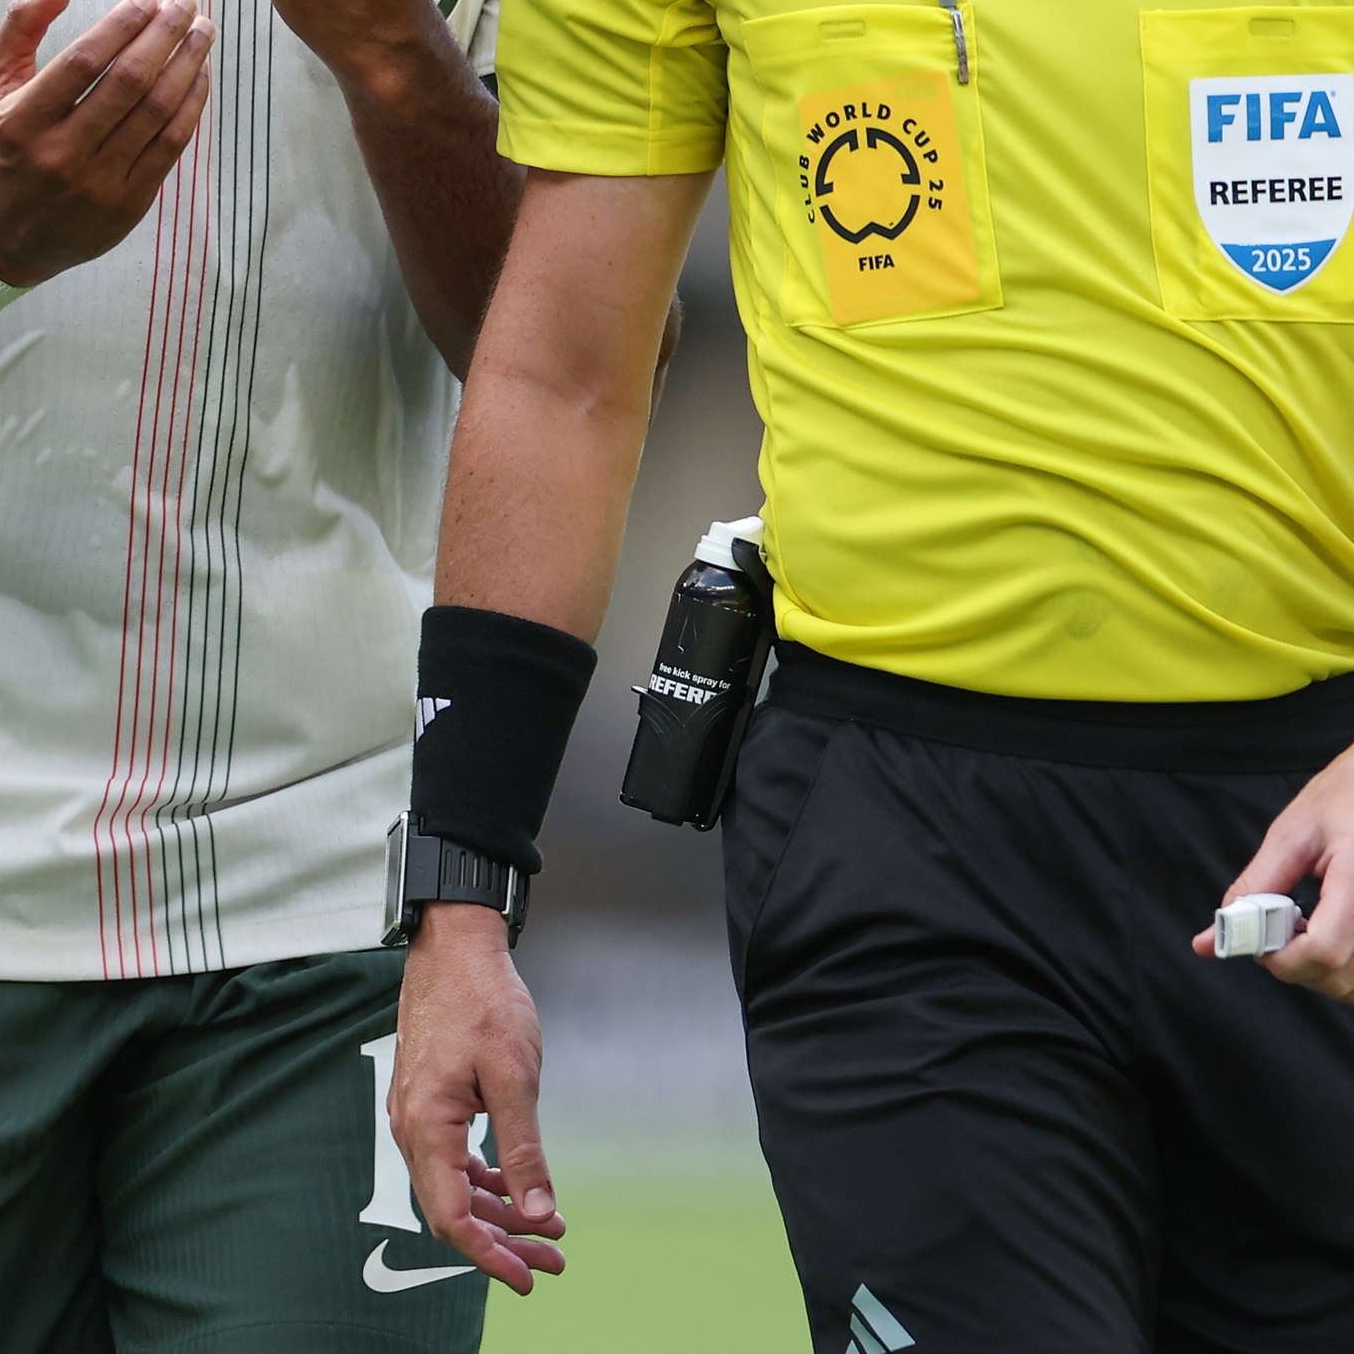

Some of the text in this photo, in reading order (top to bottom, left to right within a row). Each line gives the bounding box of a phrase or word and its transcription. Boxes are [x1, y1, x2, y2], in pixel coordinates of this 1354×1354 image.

[1207, 91, 1342, 143] FIFA
[799, 102, 944, 224] CLUB WORLD CUP 25
[1210, 176, 1343, 206] REFEREE
[858, 254, 895, 272] FIFA
[1251, 248, 1311, 273] 2025
[659, 662, 732, 690] free kick spray for
